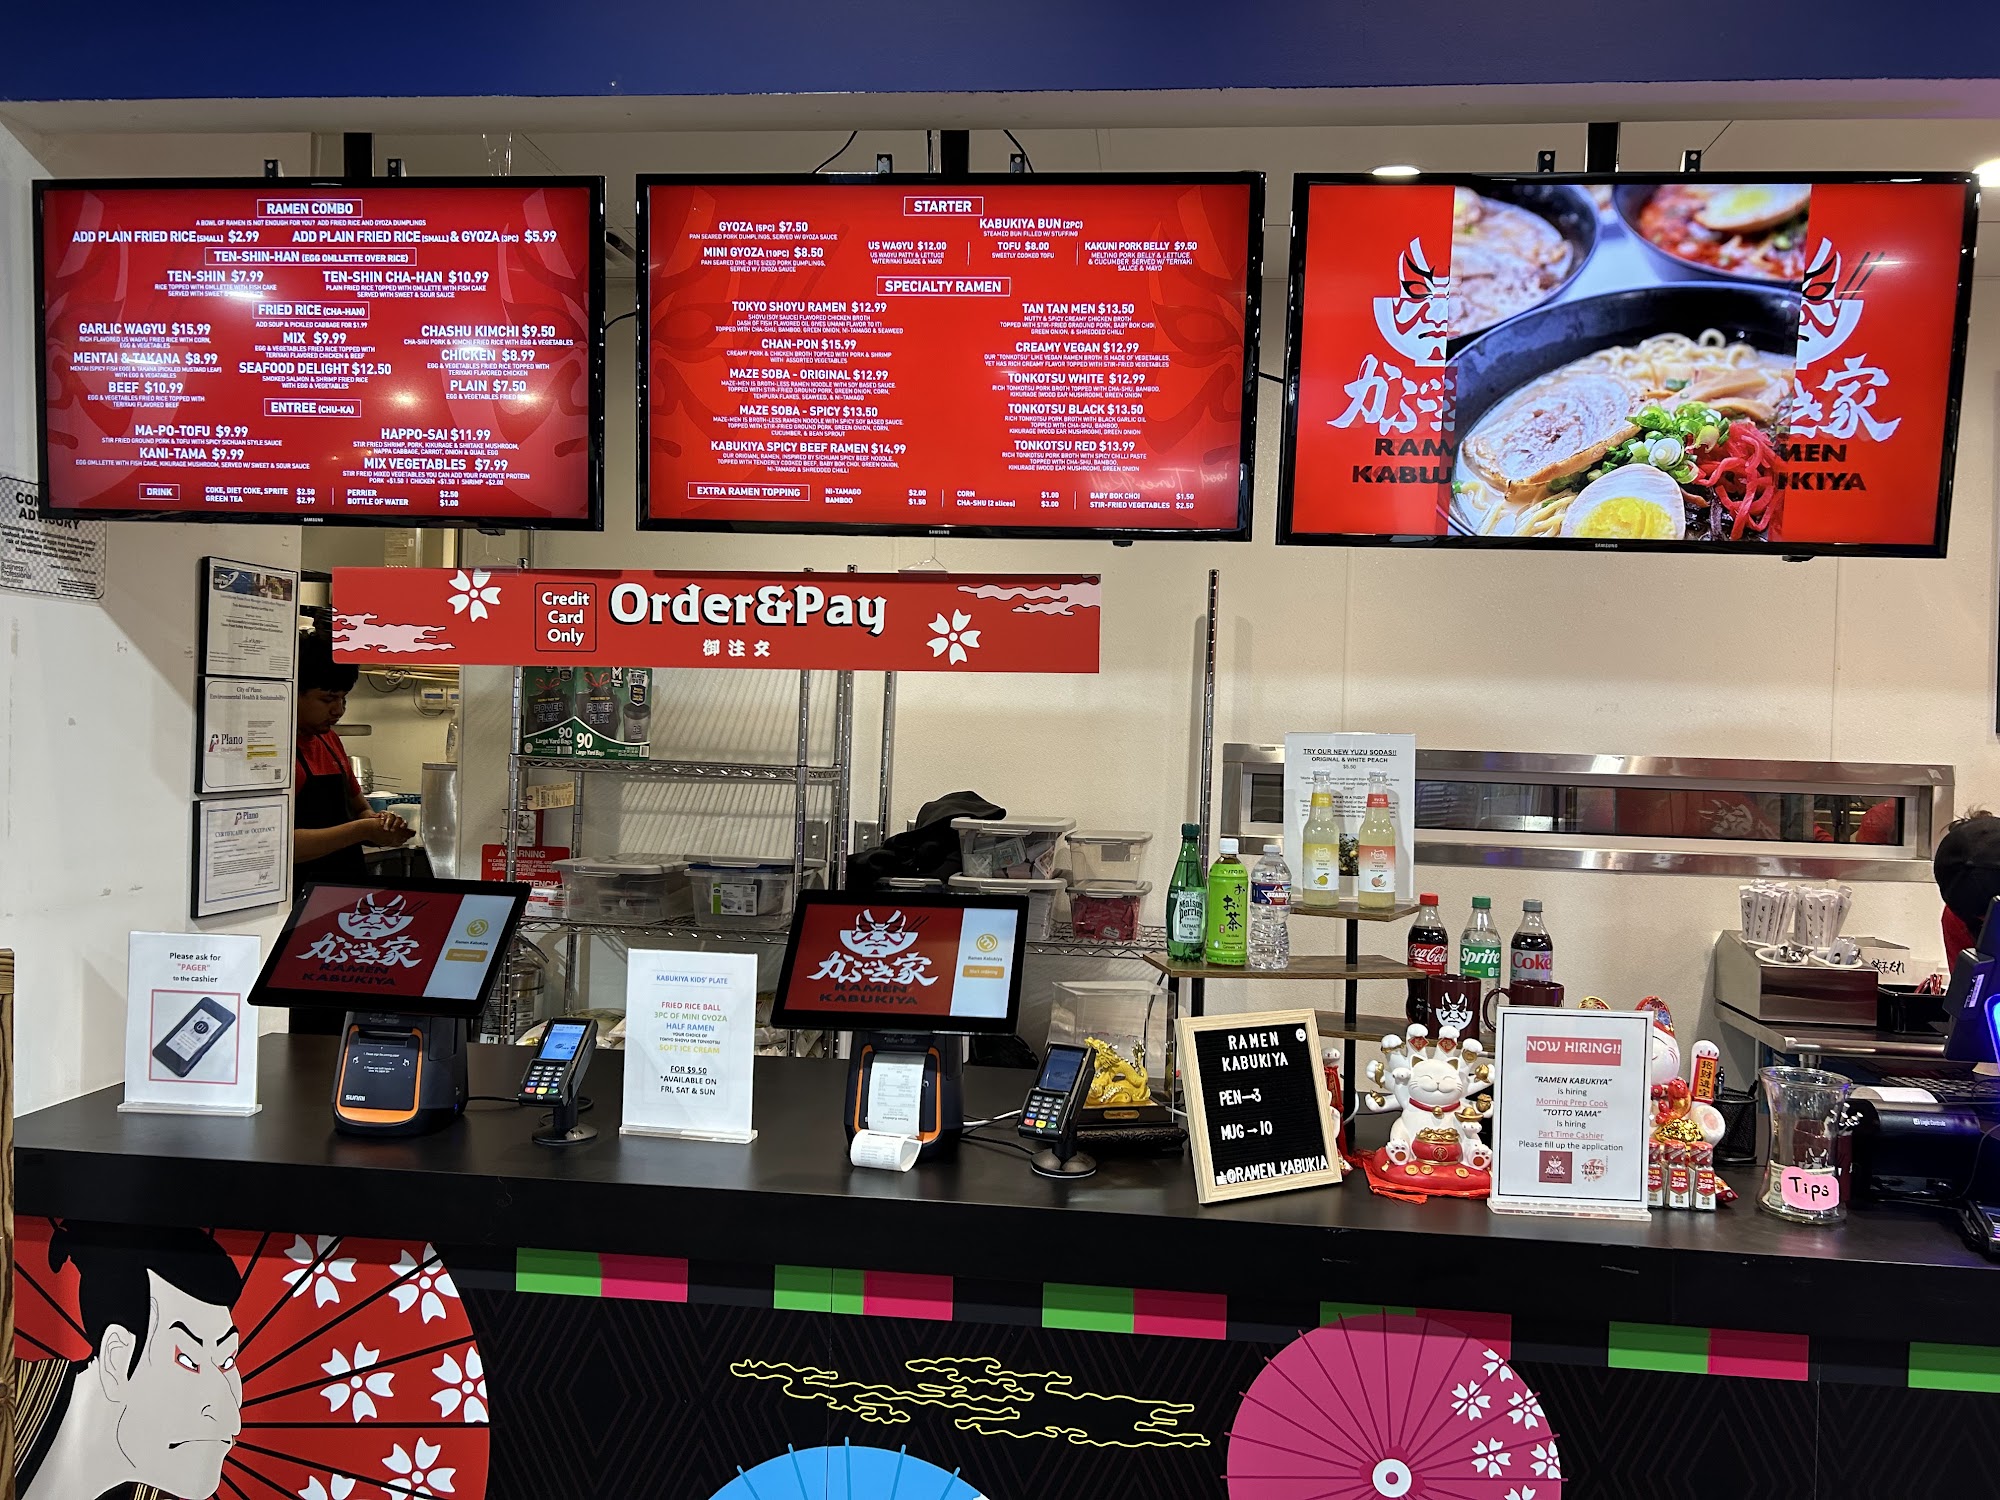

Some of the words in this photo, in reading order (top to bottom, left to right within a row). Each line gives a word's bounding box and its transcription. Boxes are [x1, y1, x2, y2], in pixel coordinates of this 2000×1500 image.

[267, 203, 309, 214] RAMEN
[311, 202, 353, 214] COMBO
[914, 200, 972, 212] STARTER
[719, 222, 753, 232] GYOZA
[756, 224, 775, 232] (5PC)
[779, 221, 808, 233] $7.50
[997, 242, 1021, 250] TOFU
[1025, 241, 1049, 251] $8.00
[323, 271, 382, 283] TEN-SHIN
[386, 271, 442, 283] CHA-HAN
[448, 271, 489, 284] $10.99
[885, 280, 953, 292] SPECIALTY
[956, 281, 1001, 292] RAMEN
[762, 339, 818, 349] CHAN-PON
[821, 339, 857, 350] $15.99
[442, 349, 496, 361] CHICKEN
[502, 350, 535, 362] $8.99
[1008, 403, 1066, 414] TONKOTSU
[1068, 404, 1105, 414] BLACK
[1107, 404, 1143, 415] $13.50
[135, 425, 210, 437] MA-PO-TOFU
[216, 425, 248, 438] $9.99
[711, 441, 765, 451] KABUKIYA
[767, 442, 797, 452] SPICY
[800, 443, 828, 452] BEEF
[830, 443, 868, 453] RAMEN
[871, 443, 906, 455] $14.99
[147, 488, 173, 496] DRINK
[697, 486, 726, 495] EXTRA
[728, 487, 760, 496] RAMEN
[762, 488, 800, 497] TOPPING
[542, 591, 590, 605] Credit
[610, 583, 887, 637] Order&Pay
[548, 609, 583, 624] Card
[547, 628, 584, 646] Only
[703, 639, 770, 657] 御注文
[222, 734, 243, 745] Plano
[576, 733, 593, 748] 90
[169, 952, 194, 960] Please
[1460, 948, 1500, 965] Sprite
[1513, 951, 1552, 970] Coke
[177, 963, 210, 971] "PAGER"
[320, 963, 389, 974] RAMEN
[191, 975, 218, 983] cashier
[302, 973, 396, 985] KABUKIYA
[834, 983, 907, 993] RAMEN
[661, 1001, 683, 1009] FRIED
[819, 994, 918, 1005] KABUKIYA
[1228, 1031, 1279, 1050] RAMEN
[660, 1044, 678, 1052] SOFT
[693, 1046, 720, 1054] CREAM
[1527, 1040, 1560, 1052] NOW
[1565, 1042, 1621, 1054] HIRING!!
[1222, 1052, 1288, 1072] KABUKIYA
[670, 1065, 685, 1074] FOR
[687, 1067, 707, 1075] $9.50
[1535, 1076, 1568, 1084] "RAMEN
[661, 1085, 674, 1094] FRI,
[676, 1086, 689, 1094] SAT
[1565, 1088, 1587, 1097] hiring
[1219, 1090, 1241, 1106] PEN
[1252, 1088, 1261, 1102] 3
[1536, 1098, 1568, 1106] Morning
[1570, 1098, 1588, 1107] Prep
[1590, 1099, 1608, 1107] Cook
[1221, 1124, 1244, 1140] MUG
[1260, 1120, 1273, 1136] 10
[1564, 1120, 1586, 1129] hiring
[1538, 1130, 1554, 1139] Part
[1555, 1130, 1574, 1139] Time
[1576, 1132, 1604, 1140] Cashier
[1519, 1140, 1543, 1148] Please
[1567, 1142, 1580, 1150] the
[1581, 1143, 1623, 1151] application
[1788, 1177, 1829, 1201] Tips
